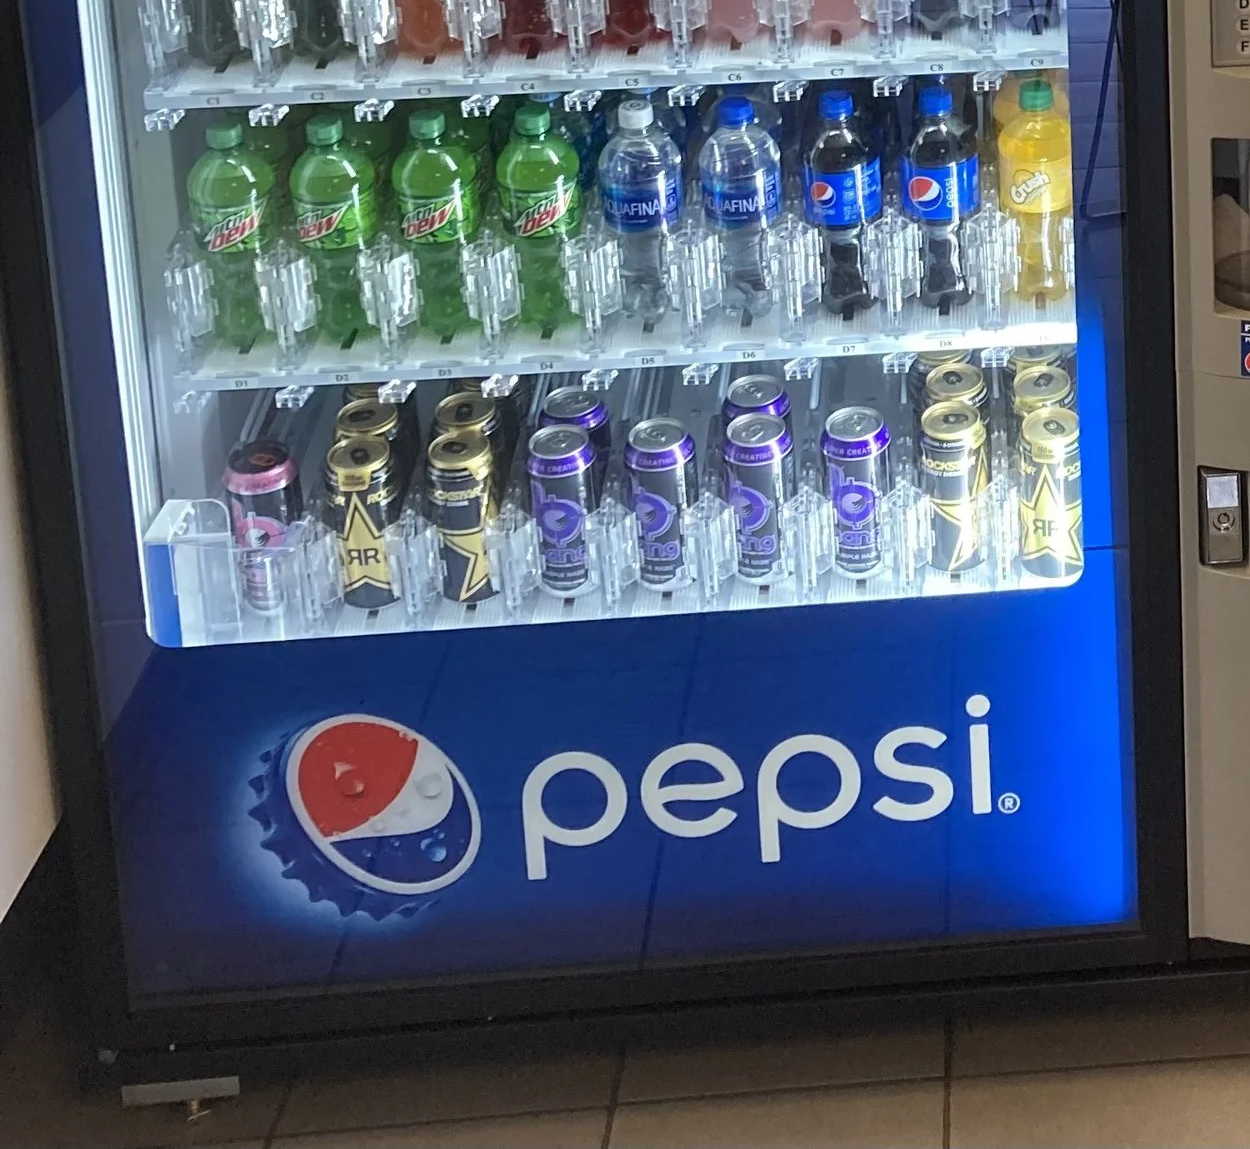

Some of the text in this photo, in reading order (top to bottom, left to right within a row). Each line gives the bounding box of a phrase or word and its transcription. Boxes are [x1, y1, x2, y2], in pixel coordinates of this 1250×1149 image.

[1240, 19, 1249, 30] E
[1241, 41, 1250, 52] F
[1031, 58, 1044, 67] C9
[930, 64, 944, 72] C8
[728, 73, 742, 81] C6
[521, 83, 535, 91] C4
[310, 92, 324, 100] C2
[1010, 170, 1051, 204] Crush
[842, 345, 855, 354] D7
[742, 351, 756, 359] D6
[641, 357, 655, 365] D5
[235, 380, 248, 388] D1
[522, 694, 992, 880] pepsi
